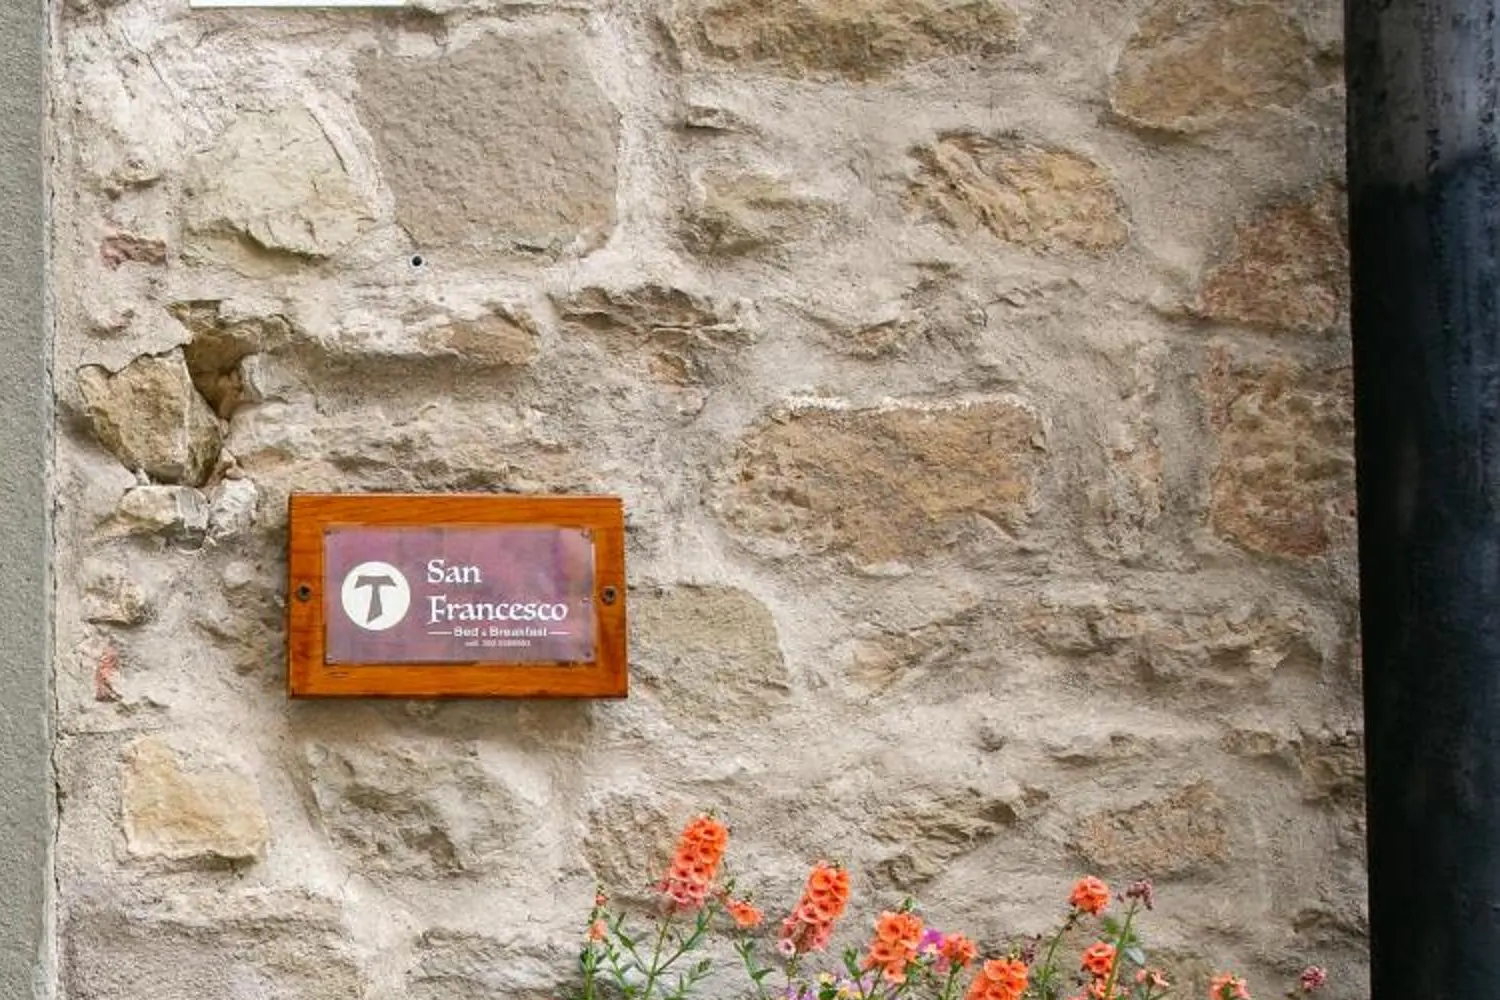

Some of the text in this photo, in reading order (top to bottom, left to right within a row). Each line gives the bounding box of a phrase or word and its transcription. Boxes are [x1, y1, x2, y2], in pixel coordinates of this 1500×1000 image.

[427, 559, 482, 584] San
[427, 595, 569, 625] Francesco
[453, 626, 479, 637] Bed
[489, 626, 548, 637] Breakfast
